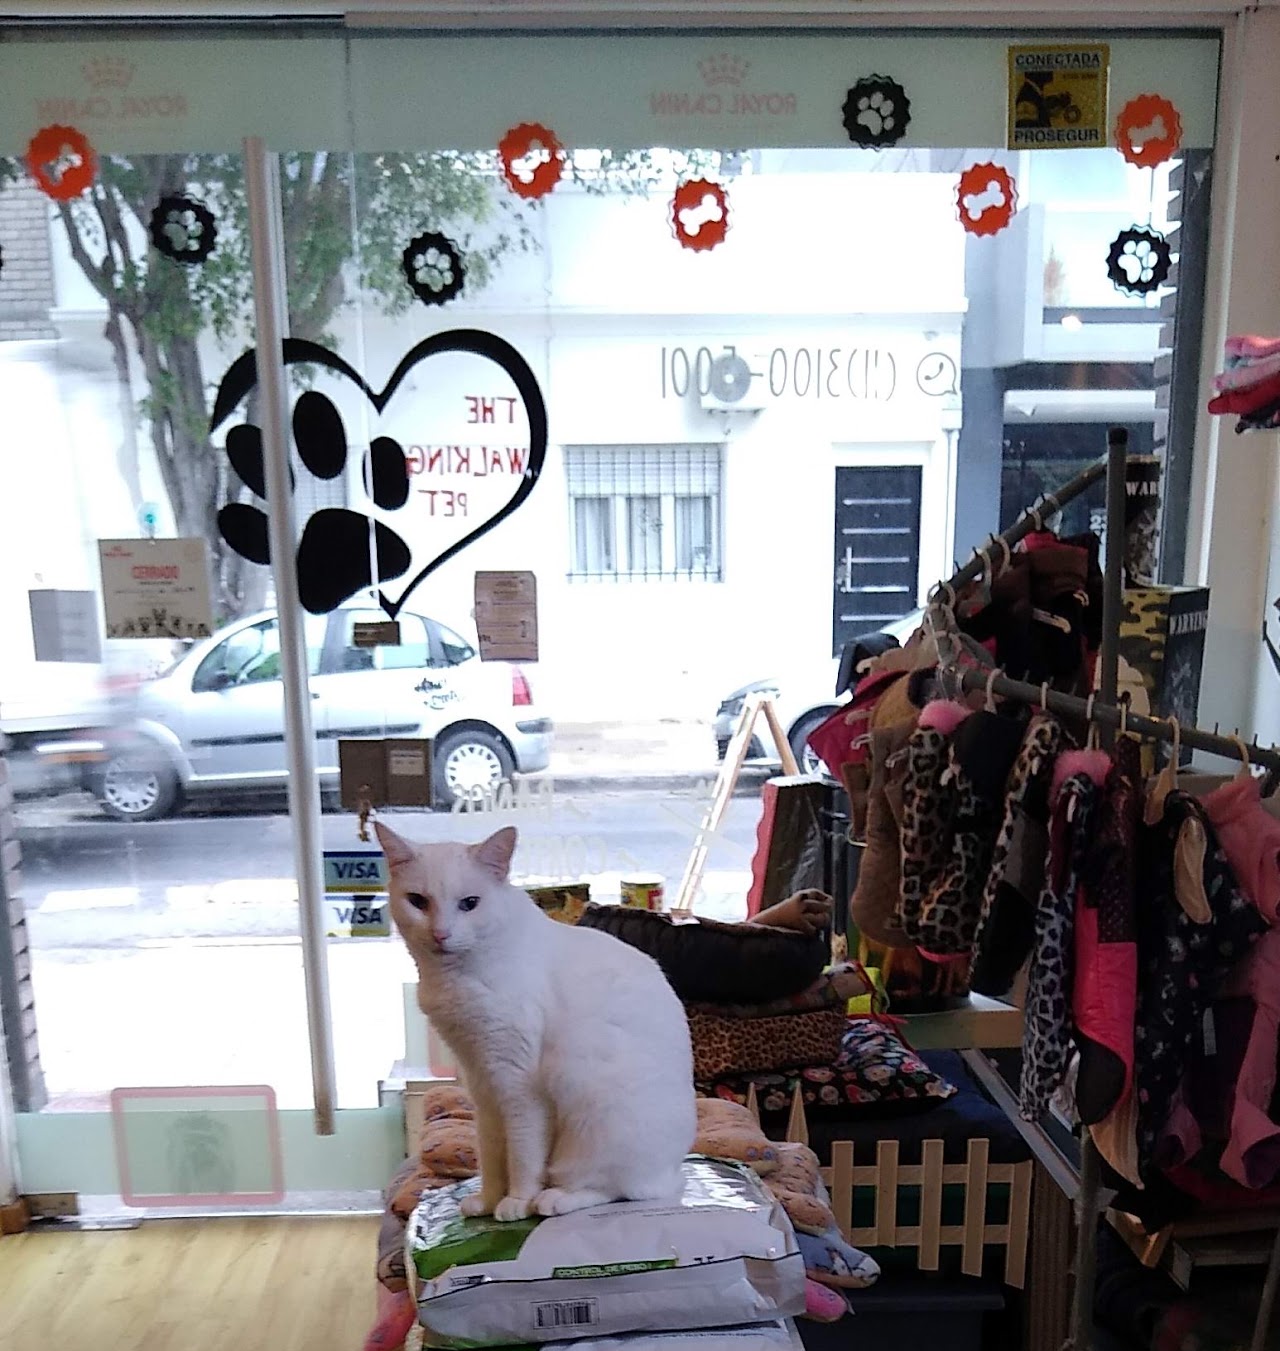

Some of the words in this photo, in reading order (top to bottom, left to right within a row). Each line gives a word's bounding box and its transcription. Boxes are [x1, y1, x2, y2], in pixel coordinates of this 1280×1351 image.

[1015, 53, 1100, 66] CONECTADA
[1014, 128, 1099, 142] PROSEGUR
[332, 862, 380, 879] VISA
[332, 906, 384, 924] VISA
